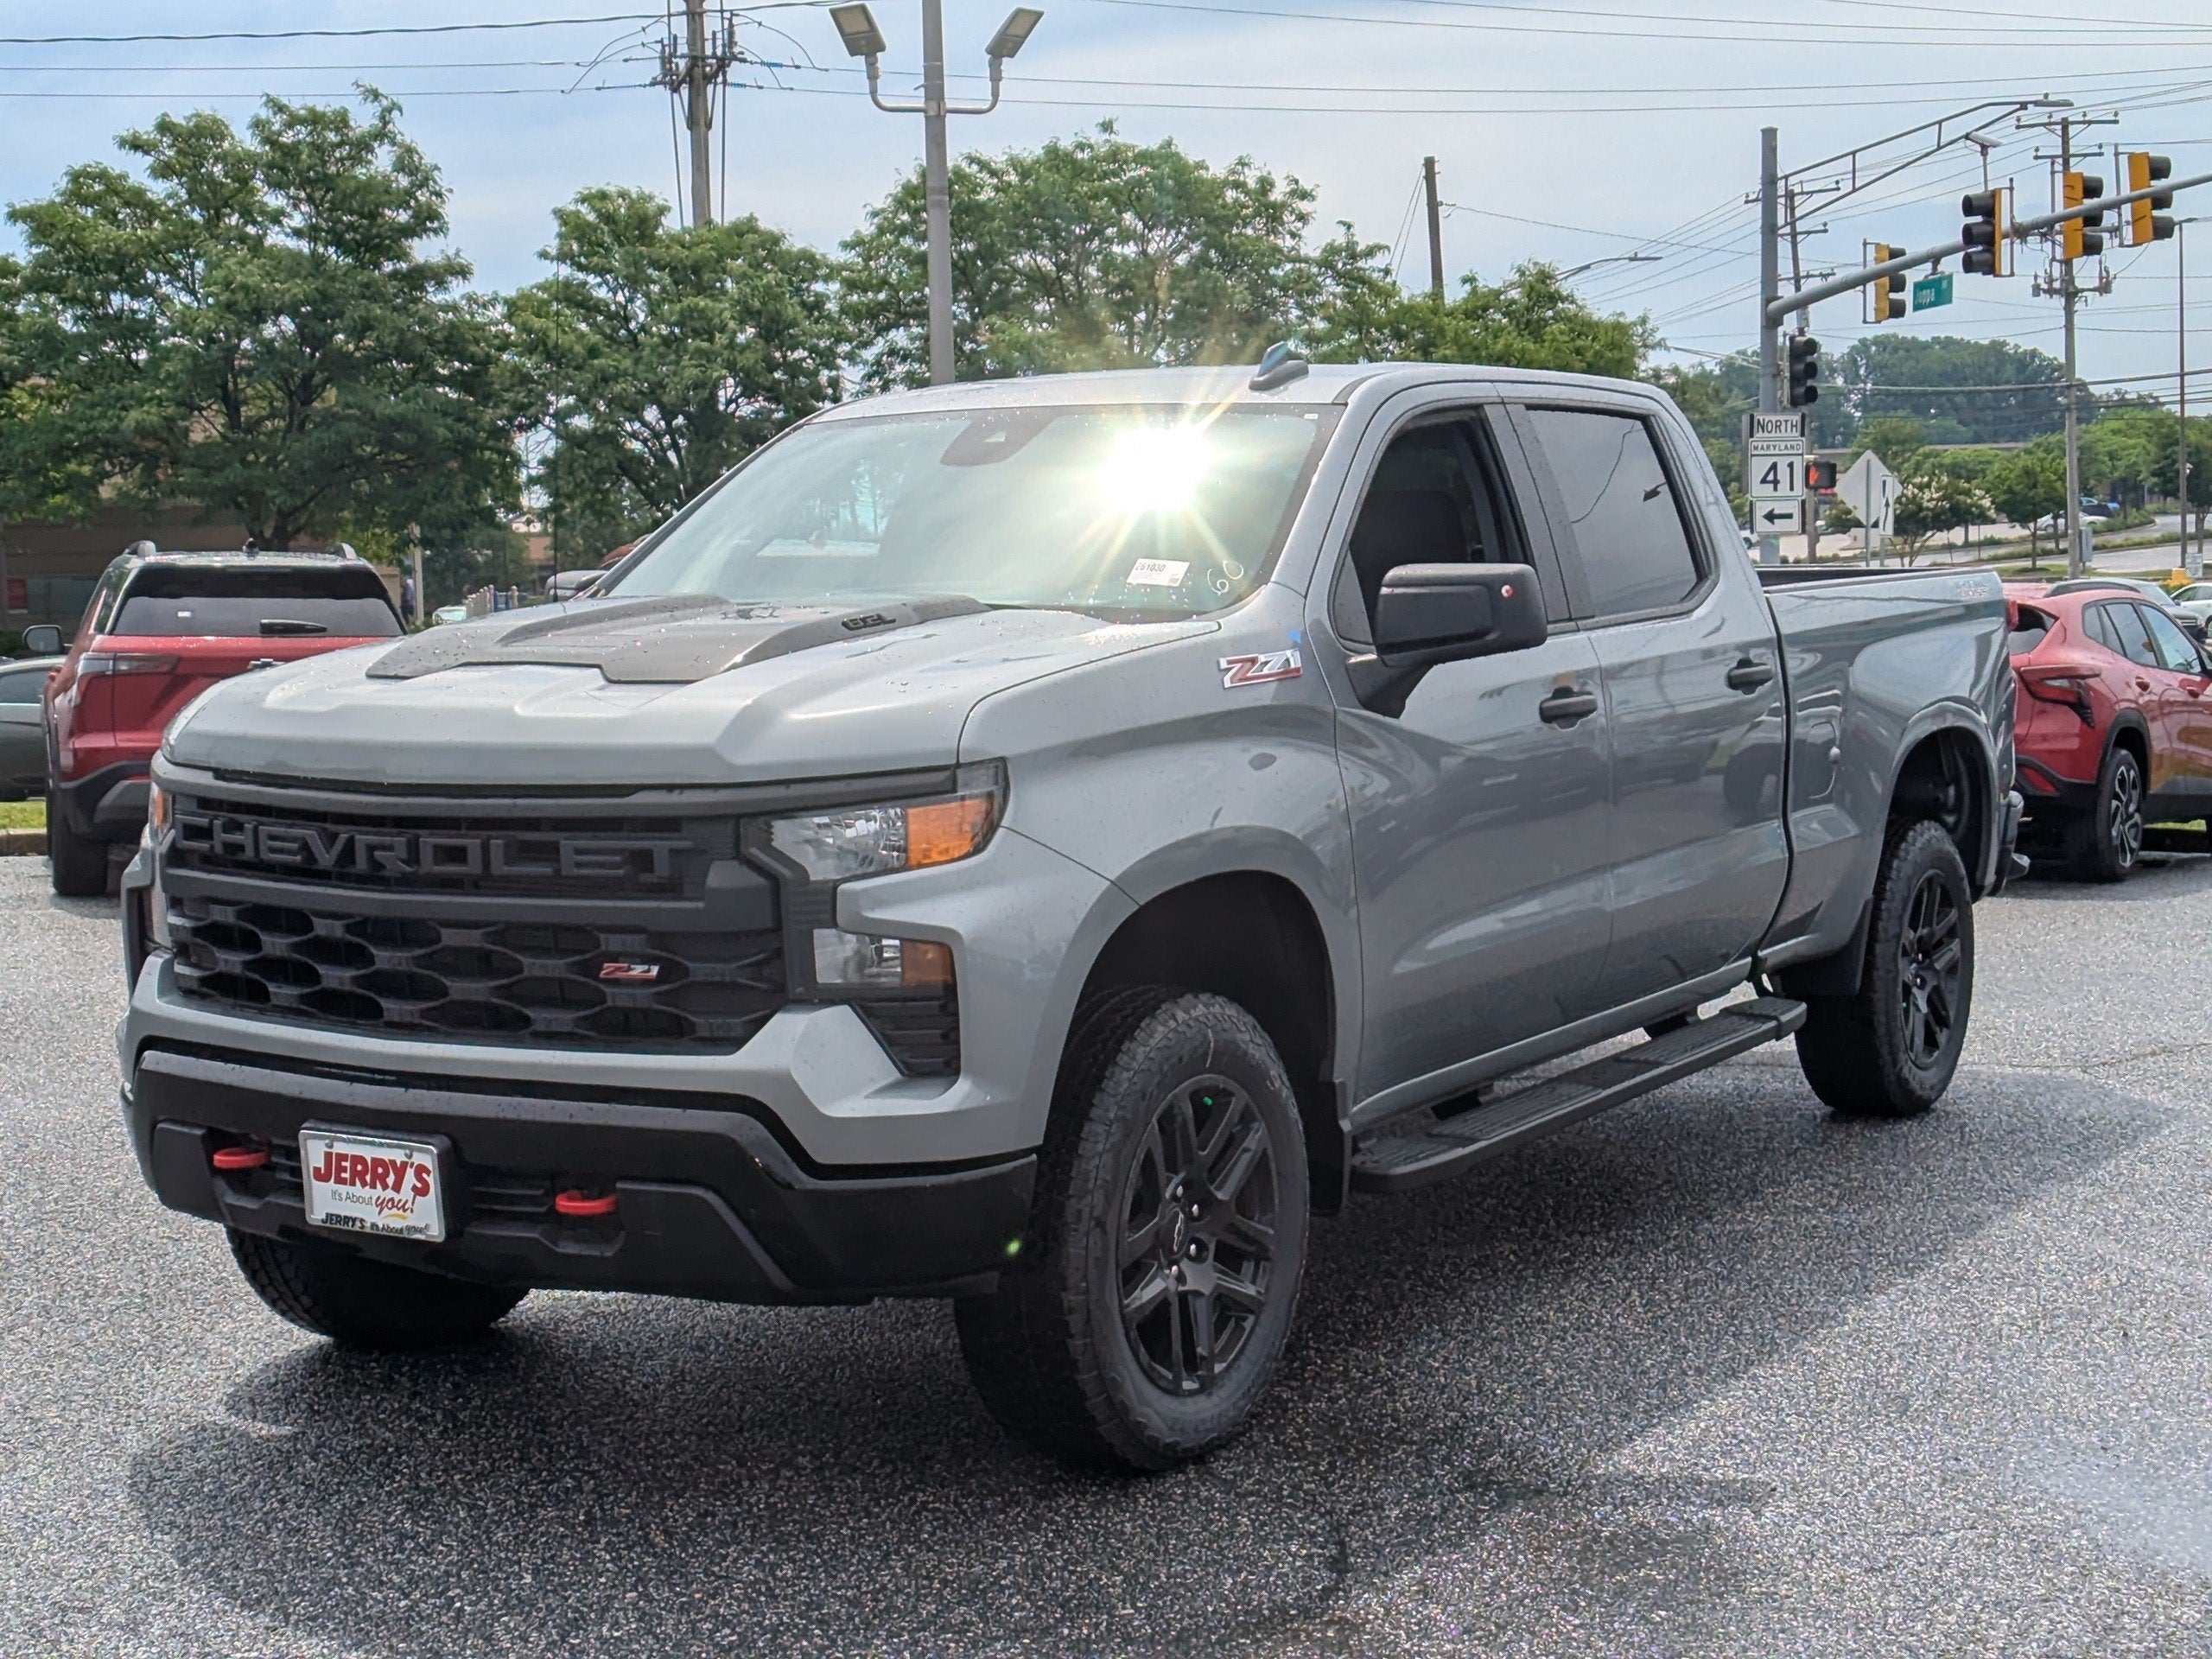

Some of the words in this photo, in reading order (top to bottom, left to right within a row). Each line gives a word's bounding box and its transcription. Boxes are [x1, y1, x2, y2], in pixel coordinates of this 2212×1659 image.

[1757, 417, 1799, 435] NORTH
[1751, 442, 1802, 452] MARYLAND
[1759, 461, 1795, 493] 41
[1218, 650, 1303, 688] Z71
[174, 814, 693, 878] CHEVROLET
[599, 963, 660, 980] Z71
[312, 1150, 432, 1198] JERRY'S
[345, 1191, 373, 1206] About
[374, 1194, 416, 1216] you!
[321, 1211, 365, 1230] JERRY'S
